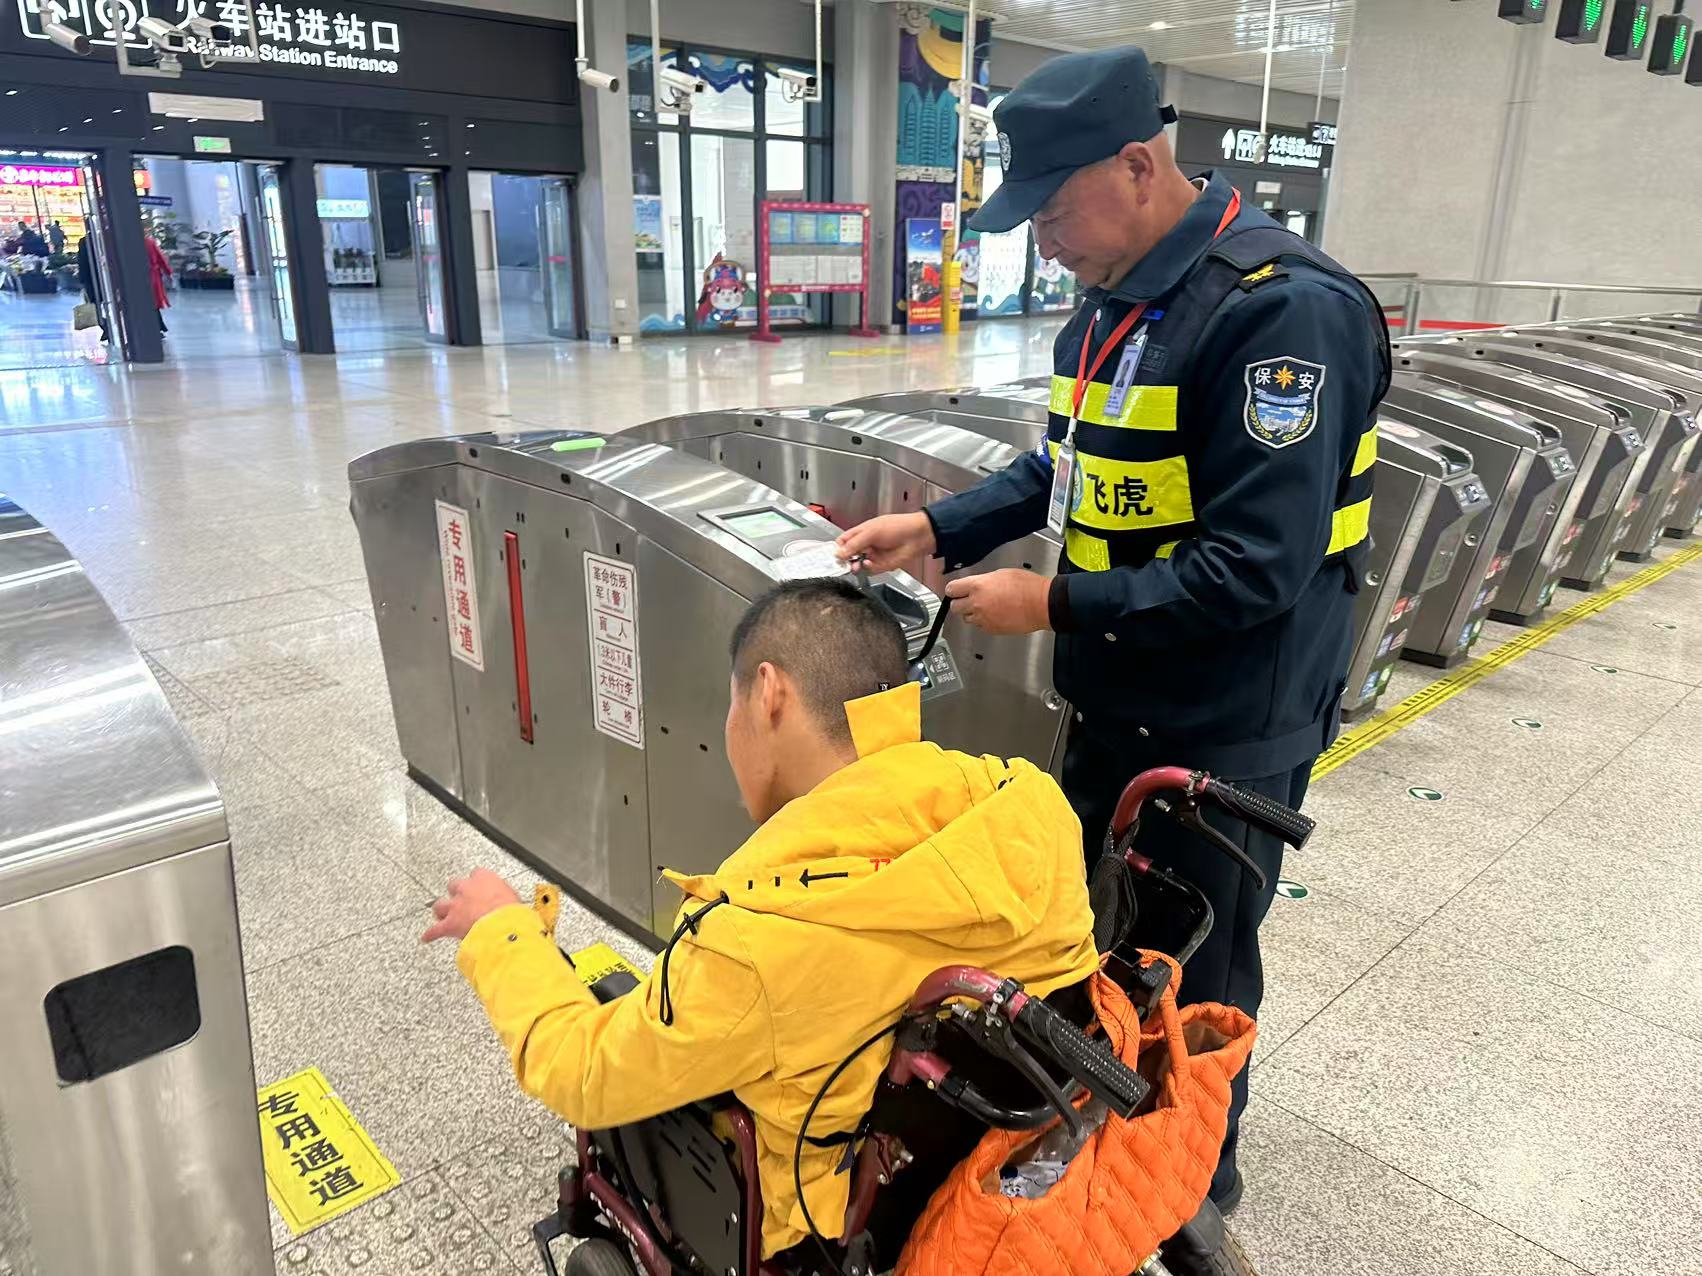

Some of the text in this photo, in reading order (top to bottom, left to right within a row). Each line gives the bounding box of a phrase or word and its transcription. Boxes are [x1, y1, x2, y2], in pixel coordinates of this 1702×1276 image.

[176, 0, 401, 53] 火车站进站口
[259, 44, 323, 67] Station
[324, 51, 399, 74] Entrance
[1086, 472, 1154, 518] 飞虎
[448, 519, 474, 654] 专用通道
[258, 1091, 364, 1206] 专用通道
